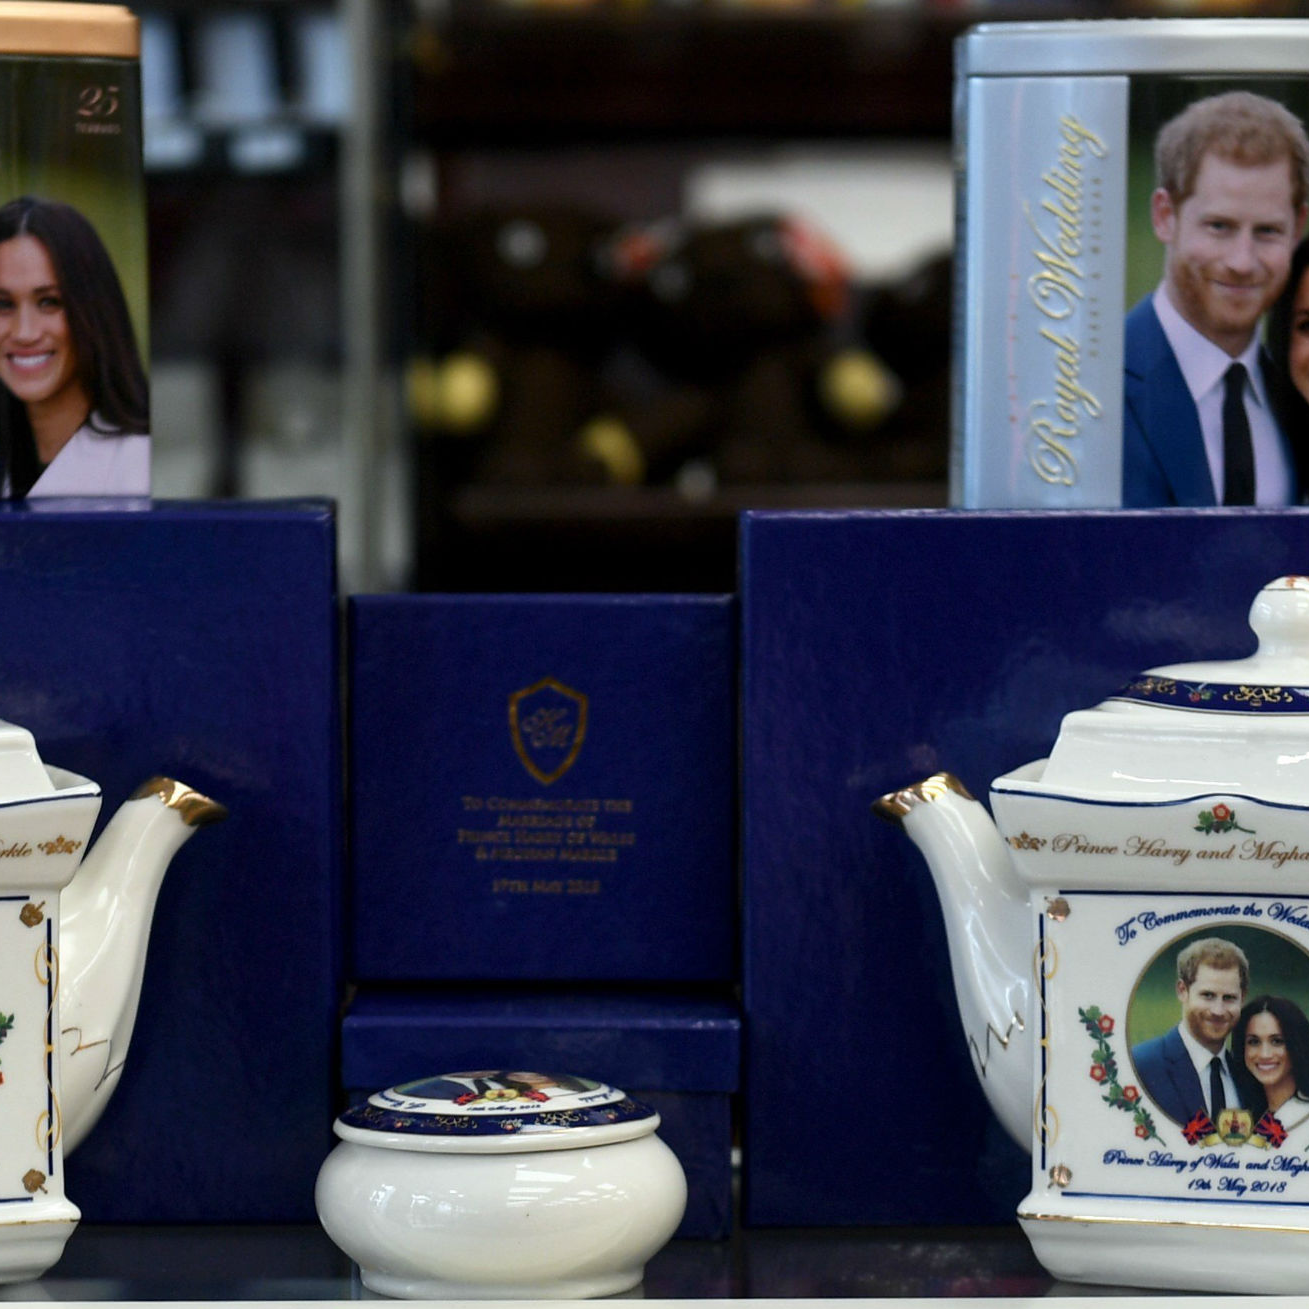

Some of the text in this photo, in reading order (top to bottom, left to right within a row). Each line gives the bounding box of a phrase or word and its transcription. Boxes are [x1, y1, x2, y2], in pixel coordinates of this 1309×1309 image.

[77, 85, 119, 116] 25
[1023, 114, 1109, 487] Royal Wedding
[1051, 833, 1119, 855] Prince
[1123, 836, 1192, 866] Harry
[1196, 843, 1234, 861] and
[1114, 916, 1137, 946] To
[1137, 904, 1240, 931] Commemorate
[1242, 902, 1263, 917] the
[1187, 1177, 1288, 1197] 19th May 2018
